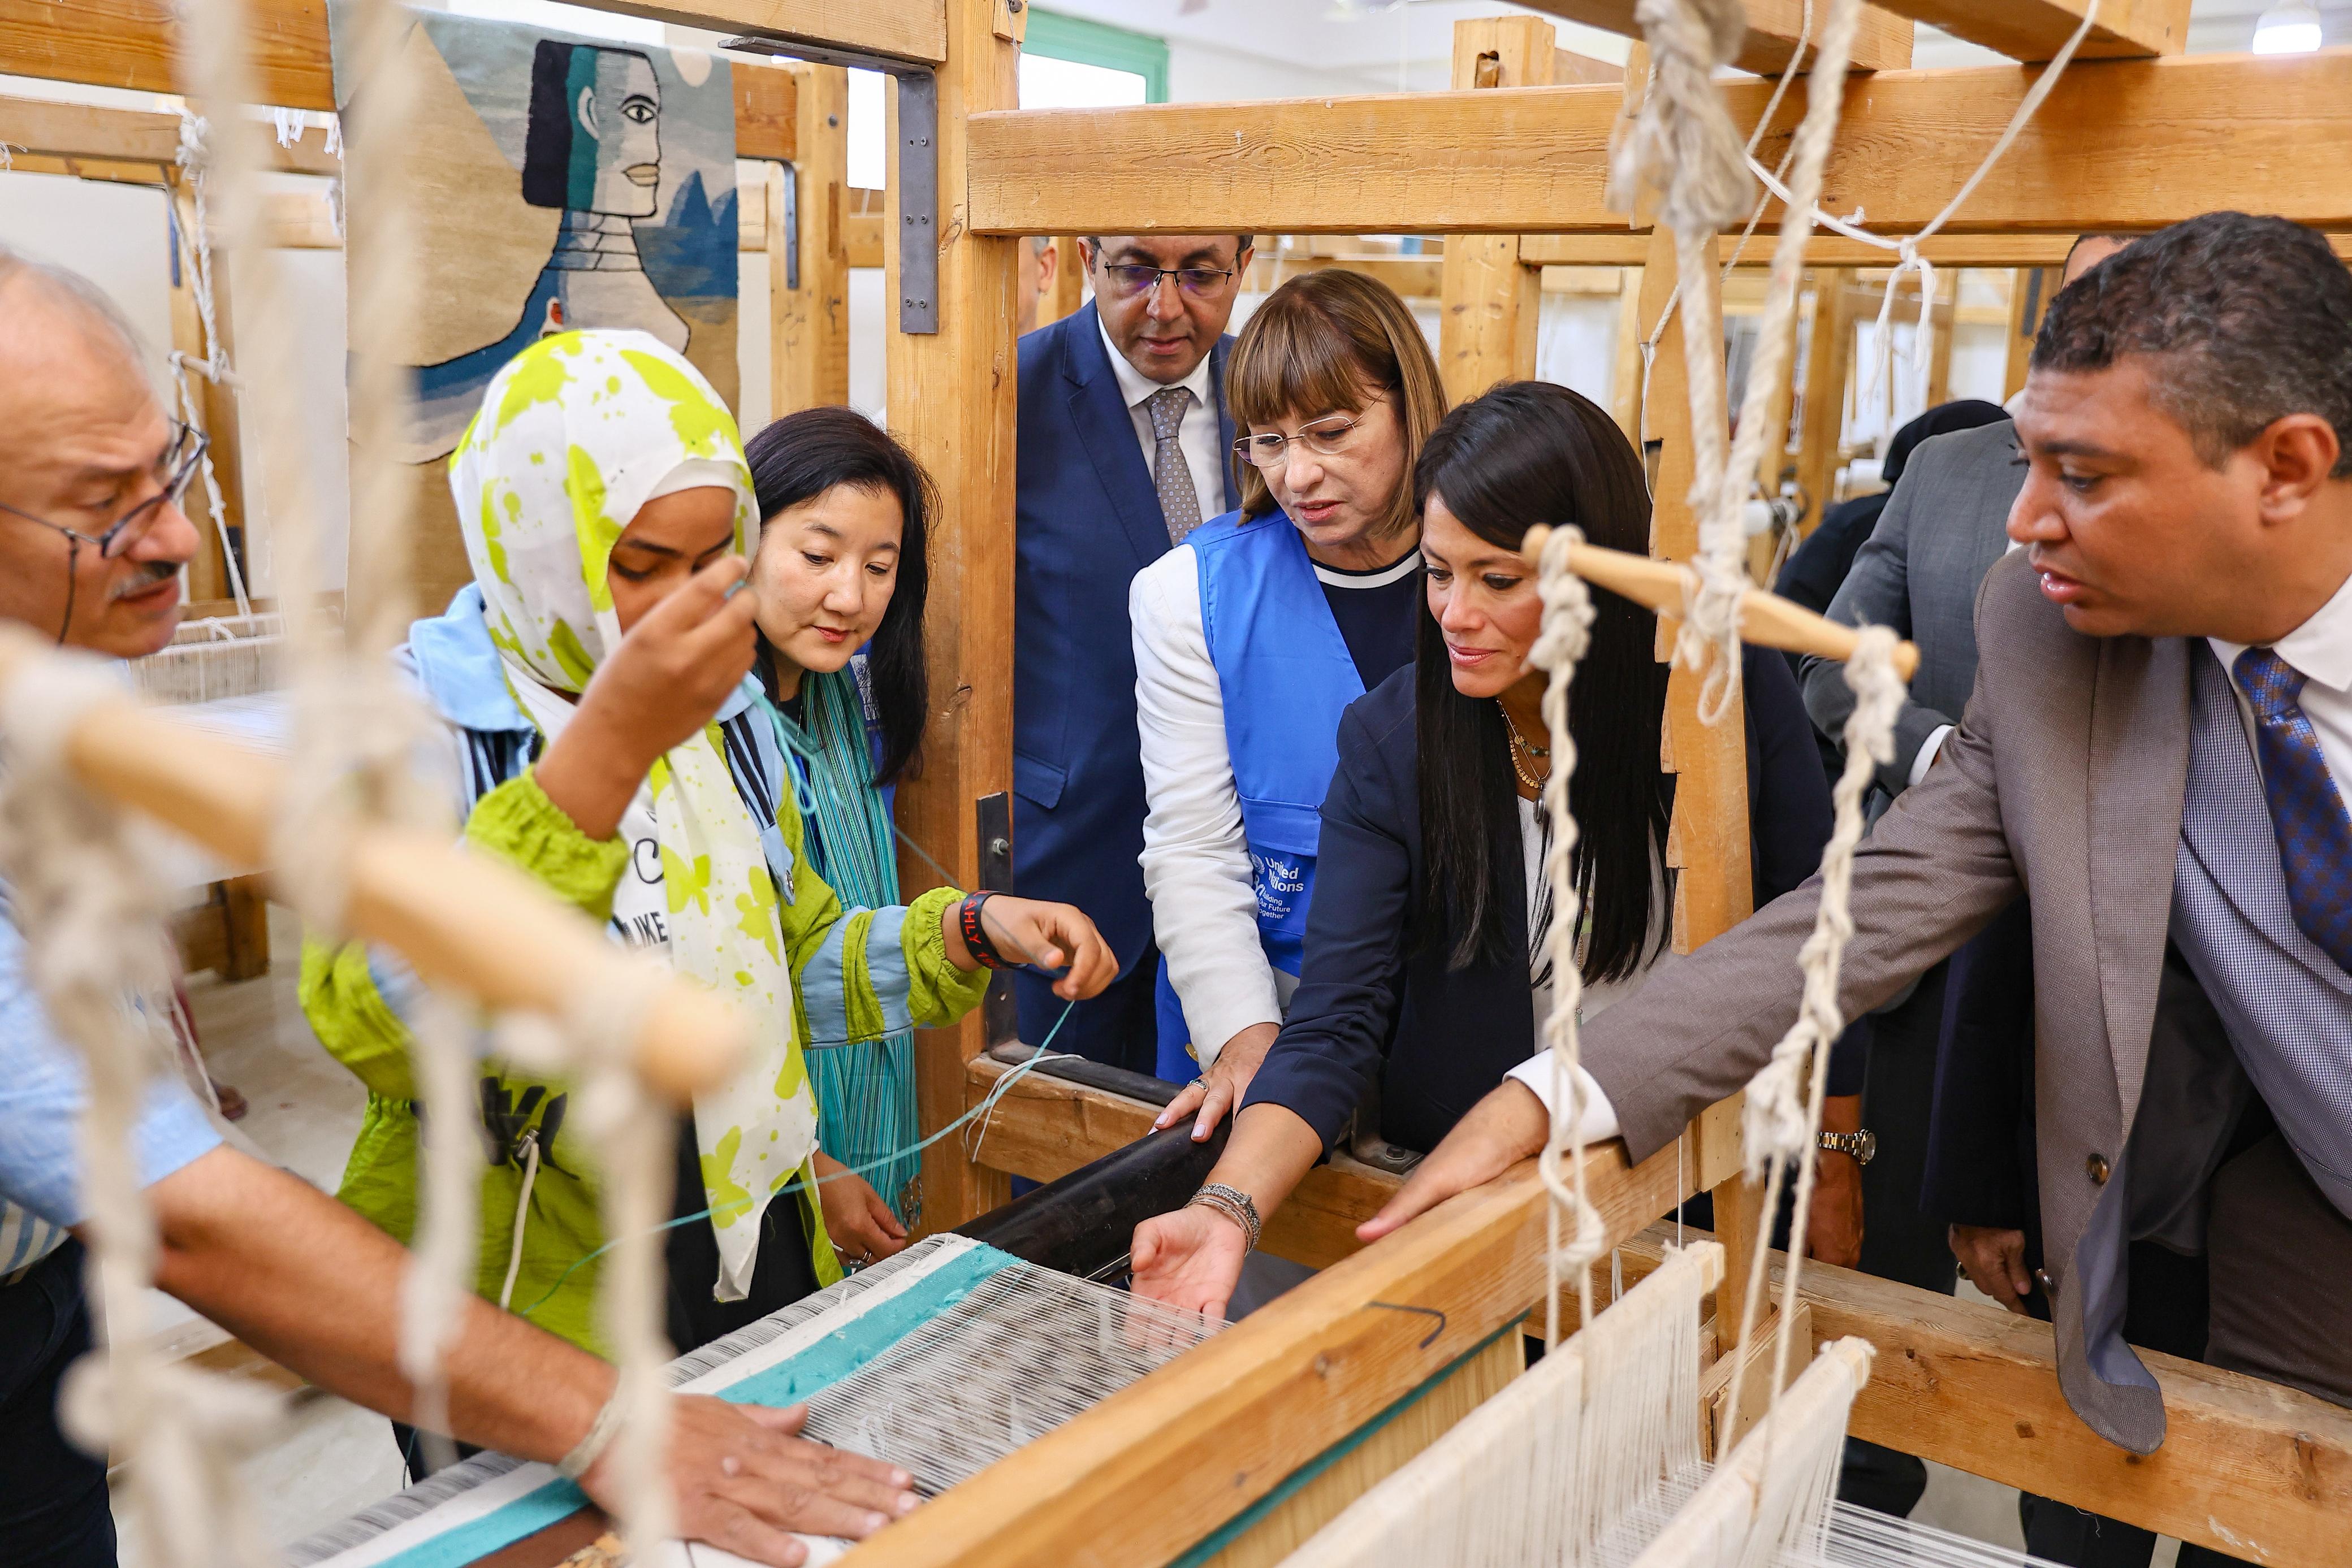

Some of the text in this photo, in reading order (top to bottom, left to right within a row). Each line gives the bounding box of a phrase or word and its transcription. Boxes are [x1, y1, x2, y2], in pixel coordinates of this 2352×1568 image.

[1265, 856, 1299, 880] United
[1259, 908, 1284, 919] ogether
[1268, 903, 1291, 912] Future
[964, 899, 982, 944] AHLY
